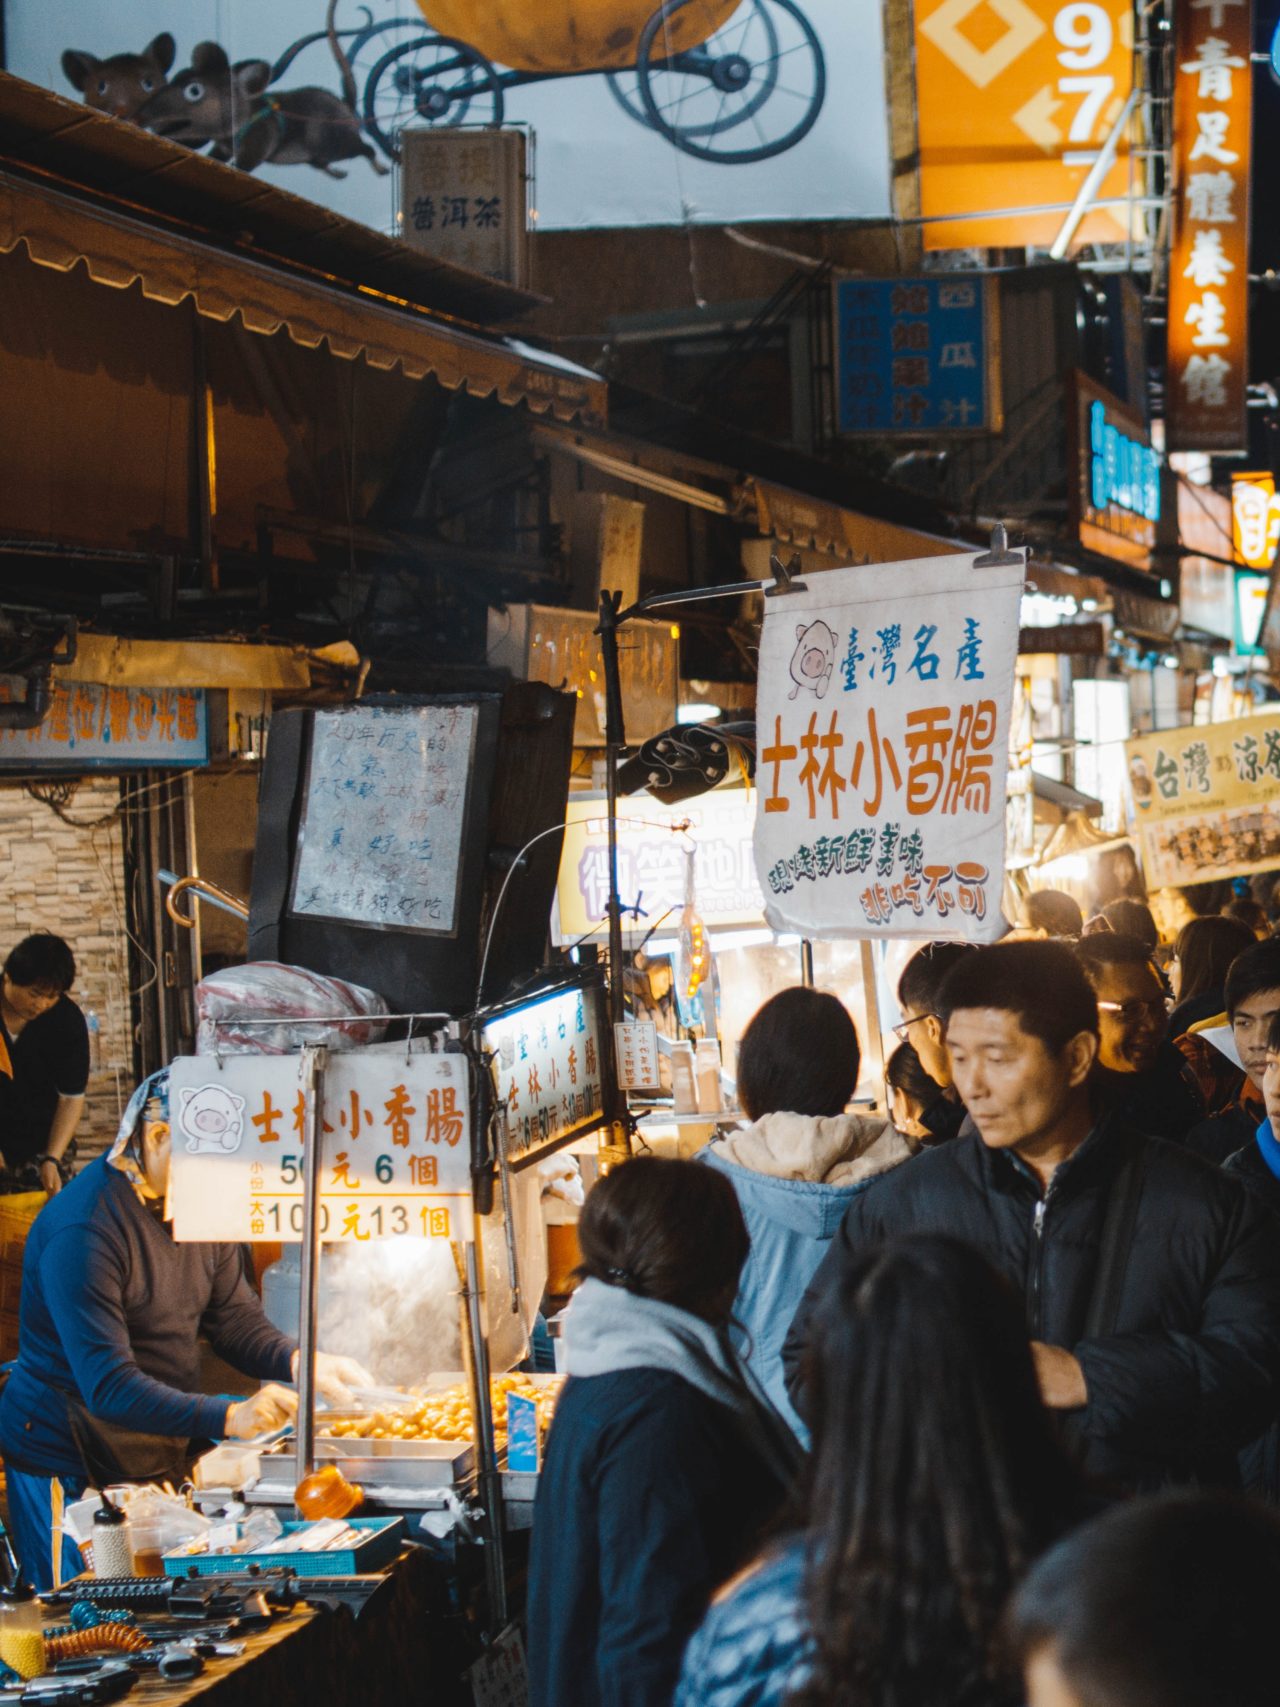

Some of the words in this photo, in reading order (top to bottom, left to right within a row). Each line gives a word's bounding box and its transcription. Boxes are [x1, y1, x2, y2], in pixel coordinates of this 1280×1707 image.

[411, 195, 501, 231] 普洱茶
[938, 282, 977, 426] 西瓜汁
[838, 617, 986, 692] 臺灣名產
[761, 698, 999, 820] 士林小香腸
[768, 822, 923, 894] 現烤新鮮美味
[860, 861, 988, 925] 非吃不可
[509, 1036, 597, 1112] 士林小香腸
[250, 1200, 265, 1235] 大份
